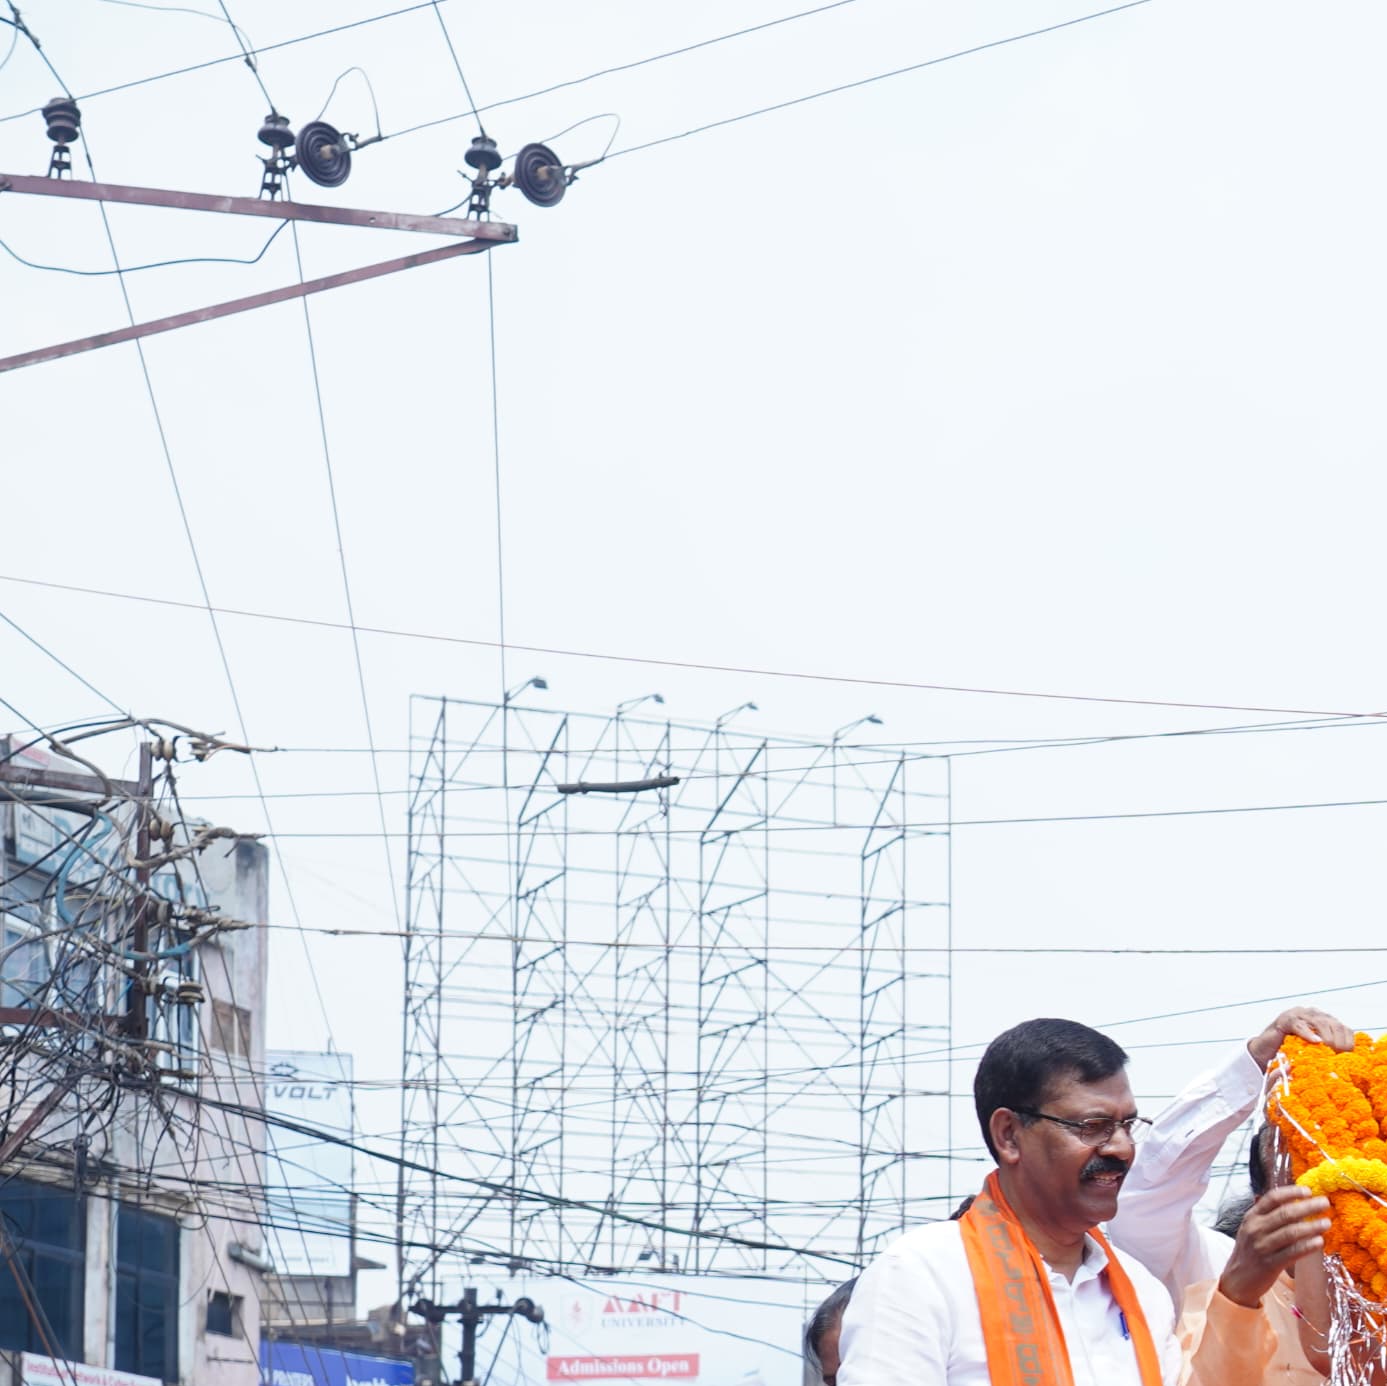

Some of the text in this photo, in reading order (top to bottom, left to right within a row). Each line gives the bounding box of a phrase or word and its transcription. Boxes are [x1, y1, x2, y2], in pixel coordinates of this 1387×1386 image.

[264, 1085, 338, 1100] VOLT
[602, 1290, 688, 1314] AAFT
[601, 1316, 687, 1329] UNIVERSITY
[558, 1357, 690, 1377] Admissions Open
